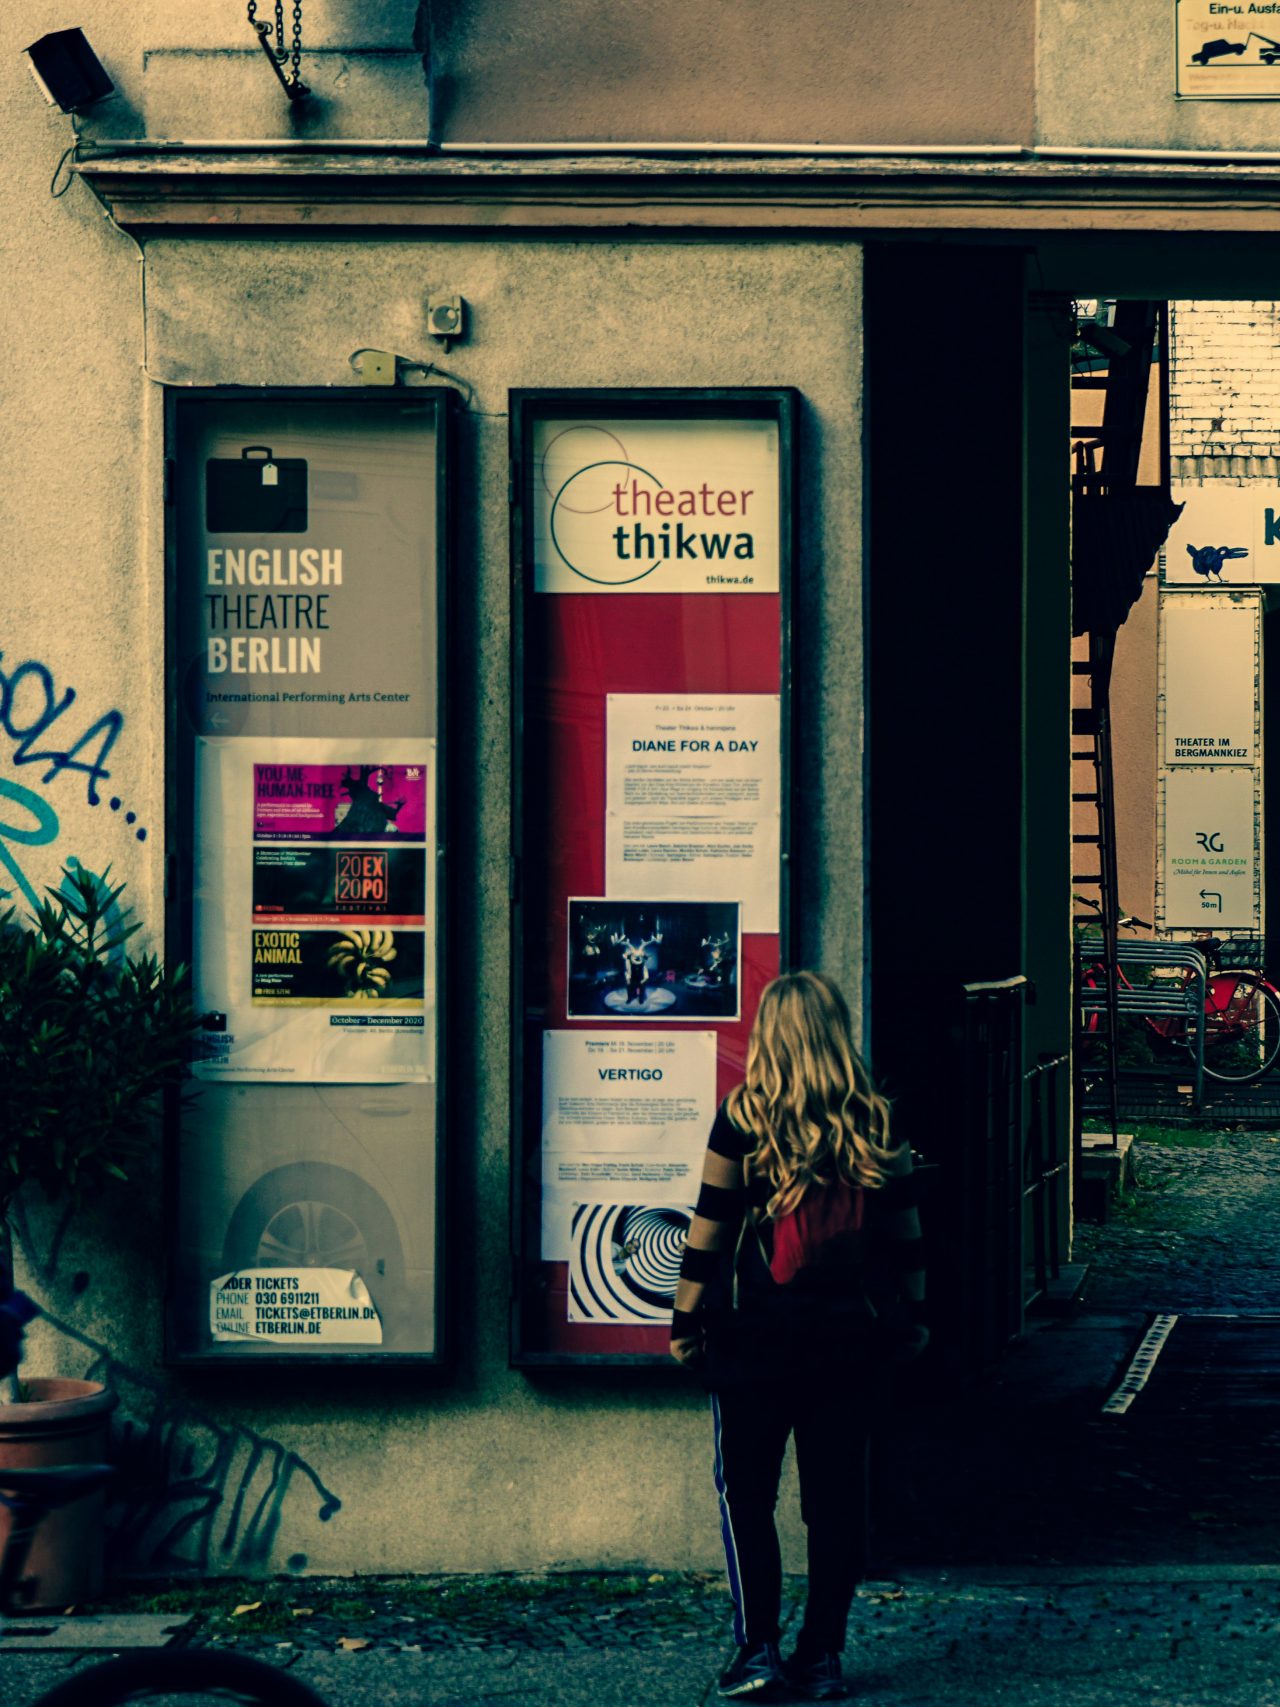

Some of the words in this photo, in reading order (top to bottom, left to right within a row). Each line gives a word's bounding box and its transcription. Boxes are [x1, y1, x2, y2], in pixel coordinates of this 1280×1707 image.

[612, 479, 754, 516] theater
[613, 522, 754, 560] thikwa
[207, 548, 342, 586] ENGLISH
[706, 575, 754, 585] thikwa.de
[205, 594, 330, 630] THEATRE
[207, 637, 321, 674] BERLIN
[206, 692, 279, 702] International
[282, 692, 346, 704] Performing
[348, 692, 371, 702] Arts
[373, 692, 410, 702] Center
[632, 740, 676, 752] DIANE
[680, 740, 710, 752] FOR
[714, 740, 725, 752] A
[729, 740, 759, 752] DAY
[1174, 738, 1214, 746] THEATER
[1218, 738, 1230, 746] IM
[1174, 749, 1248, 757] BERGMANNKIEZ
[1195, 832, 1224, 852] RG
[255, 932, 300, 948] EXOTIC
[254, 948, 304, 964] ANIMAL
[332, 1016, 360, 1024] October
[367, 1016, 403, 1024] December
[598, 1068, 663, 1081] VERTIGO
[256, 1278, 299, 1290] TICKETS
[216, 1292, 249, 1305] PHONE
[256, 1292, 277, 1305] 030
[280, 1292, 320, 1305] 6911211
[216, 1307, 244, 1320] EMAIL
[256, 1307, 376, 1320] TICKETS@ETBERLIN.DE
[256, 1322, 322, 1334] ETBERLIN.DE
